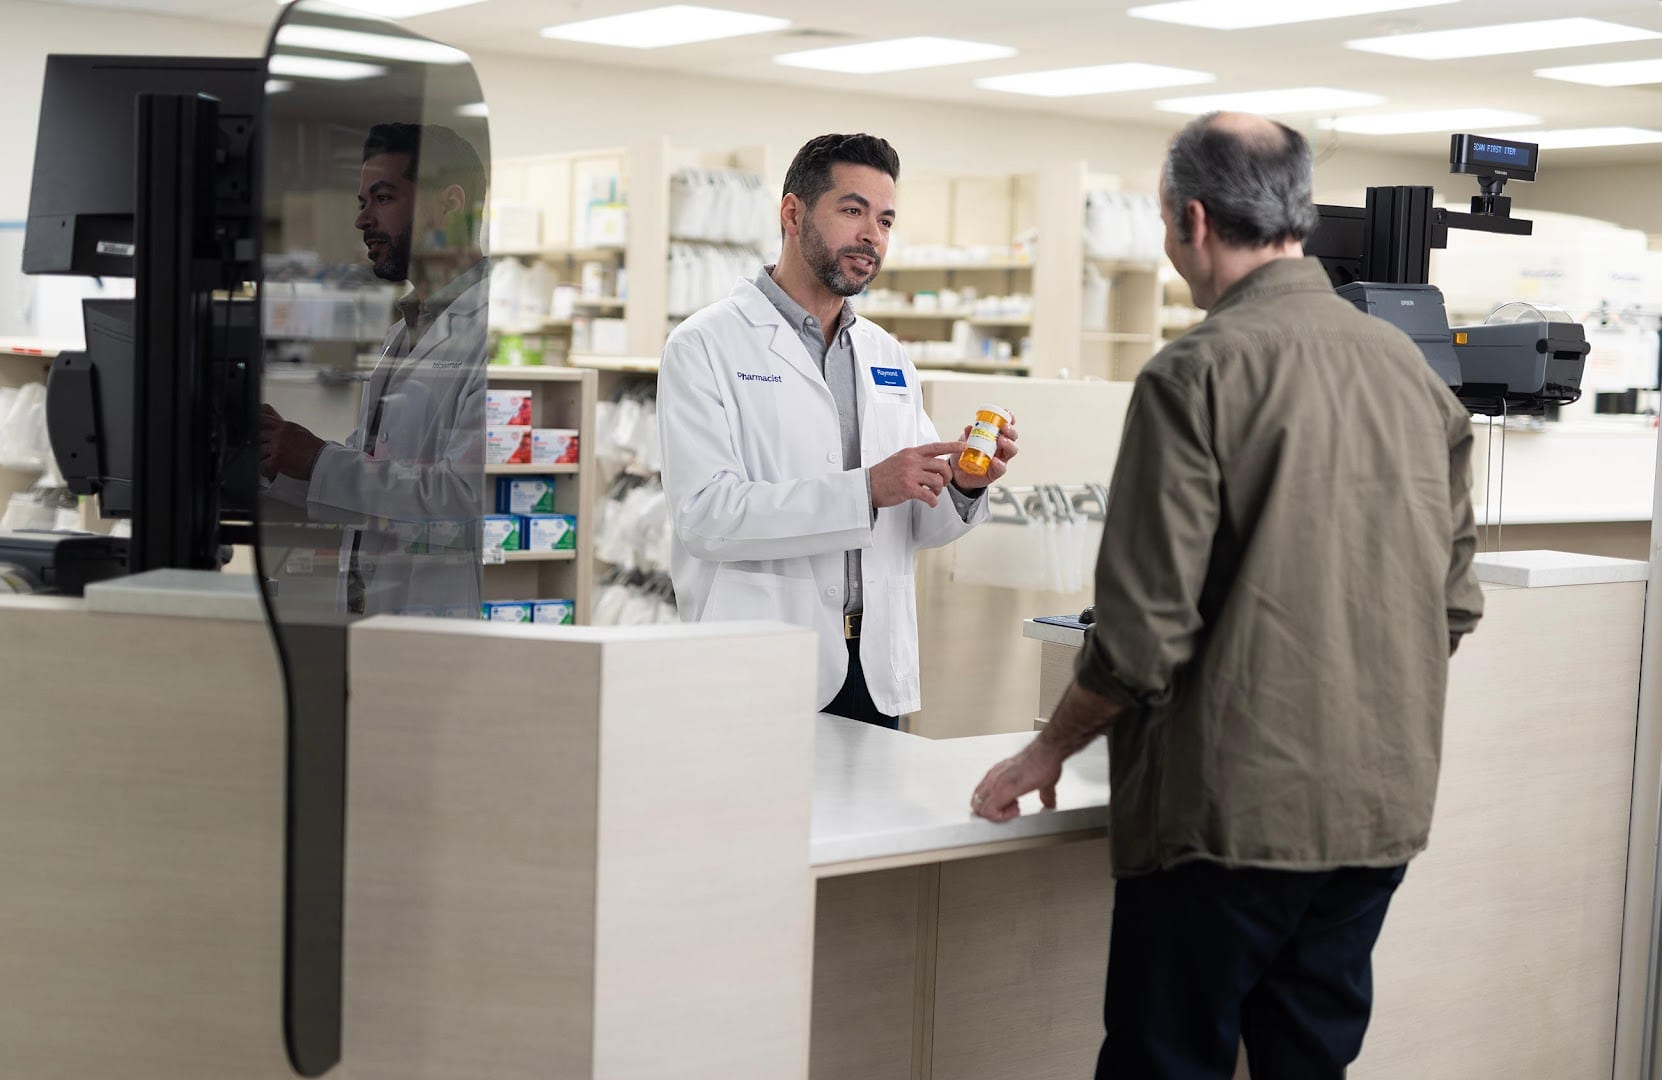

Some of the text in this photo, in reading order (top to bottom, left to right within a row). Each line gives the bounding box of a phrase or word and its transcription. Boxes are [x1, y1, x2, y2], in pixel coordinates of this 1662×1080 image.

[1473, 142, 1516, 155] SCAN FIRST ITEM
[736, 371, 782, 382] Pharmacist
[876, 369, 898, 377] Raymond
